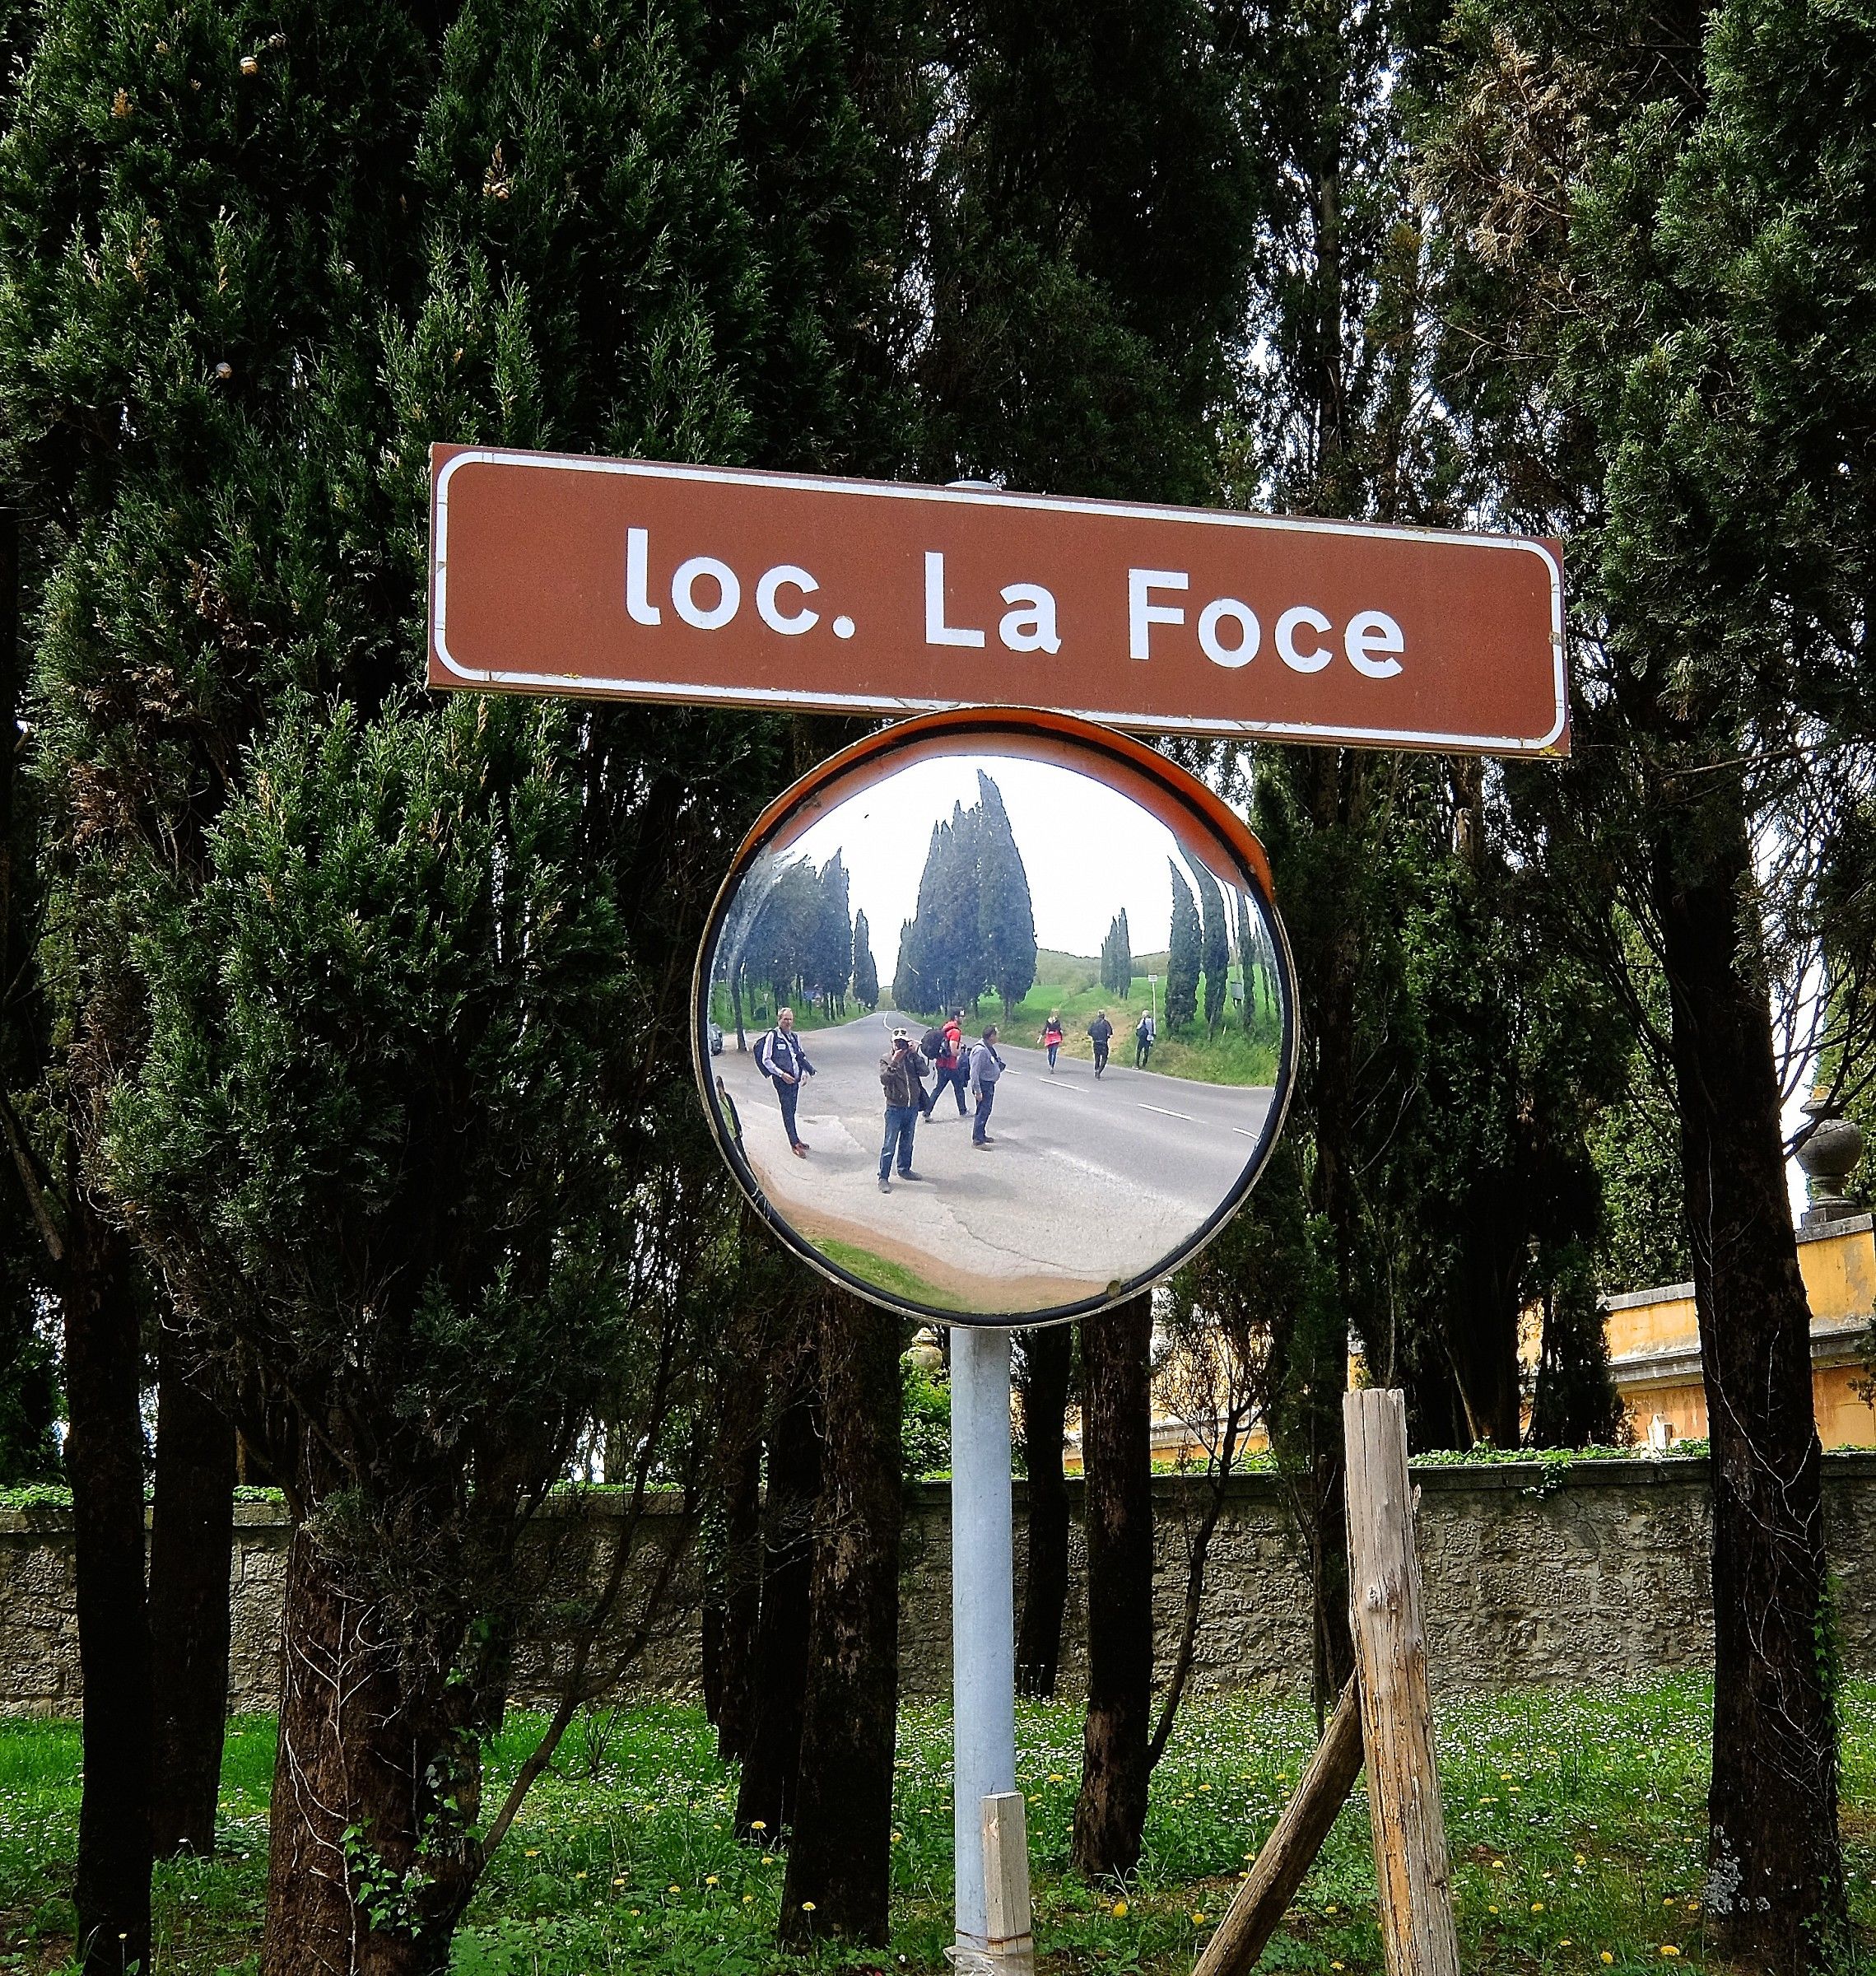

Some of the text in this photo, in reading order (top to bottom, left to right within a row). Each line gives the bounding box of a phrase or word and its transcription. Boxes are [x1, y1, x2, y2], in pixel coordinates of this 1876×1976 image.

[626, 527, 1404, 679] loc. La Foce
